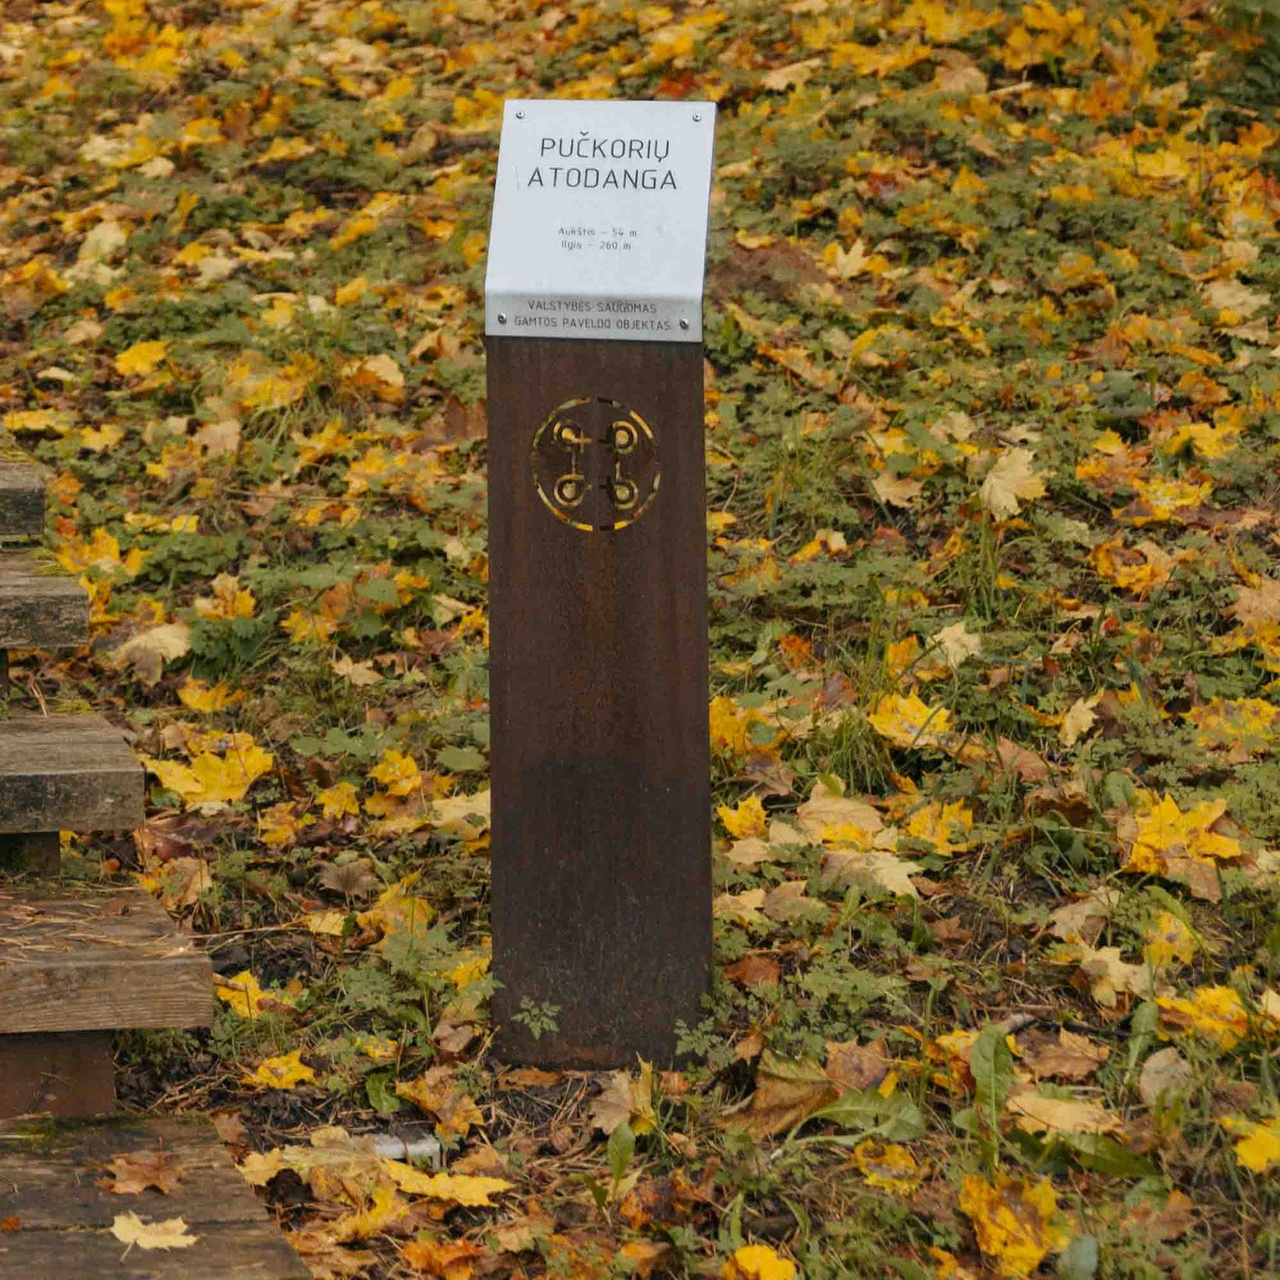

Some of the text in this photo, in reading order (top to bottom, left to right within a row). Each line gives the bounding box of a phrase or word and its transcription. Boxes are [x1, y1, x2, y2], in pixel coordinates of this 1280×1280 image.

[540, 131, 670, 163] PUČKORIŲ
[527, 167, 677, 190] ATODANGA
[600, 241, 618, 250] 260
[623, 243, 632, 251] m
[597, 302, 657, 314] SAUGOMAS
[514, 317, 671, 331] GAMTOS PAVELDO OBJEKTAS
